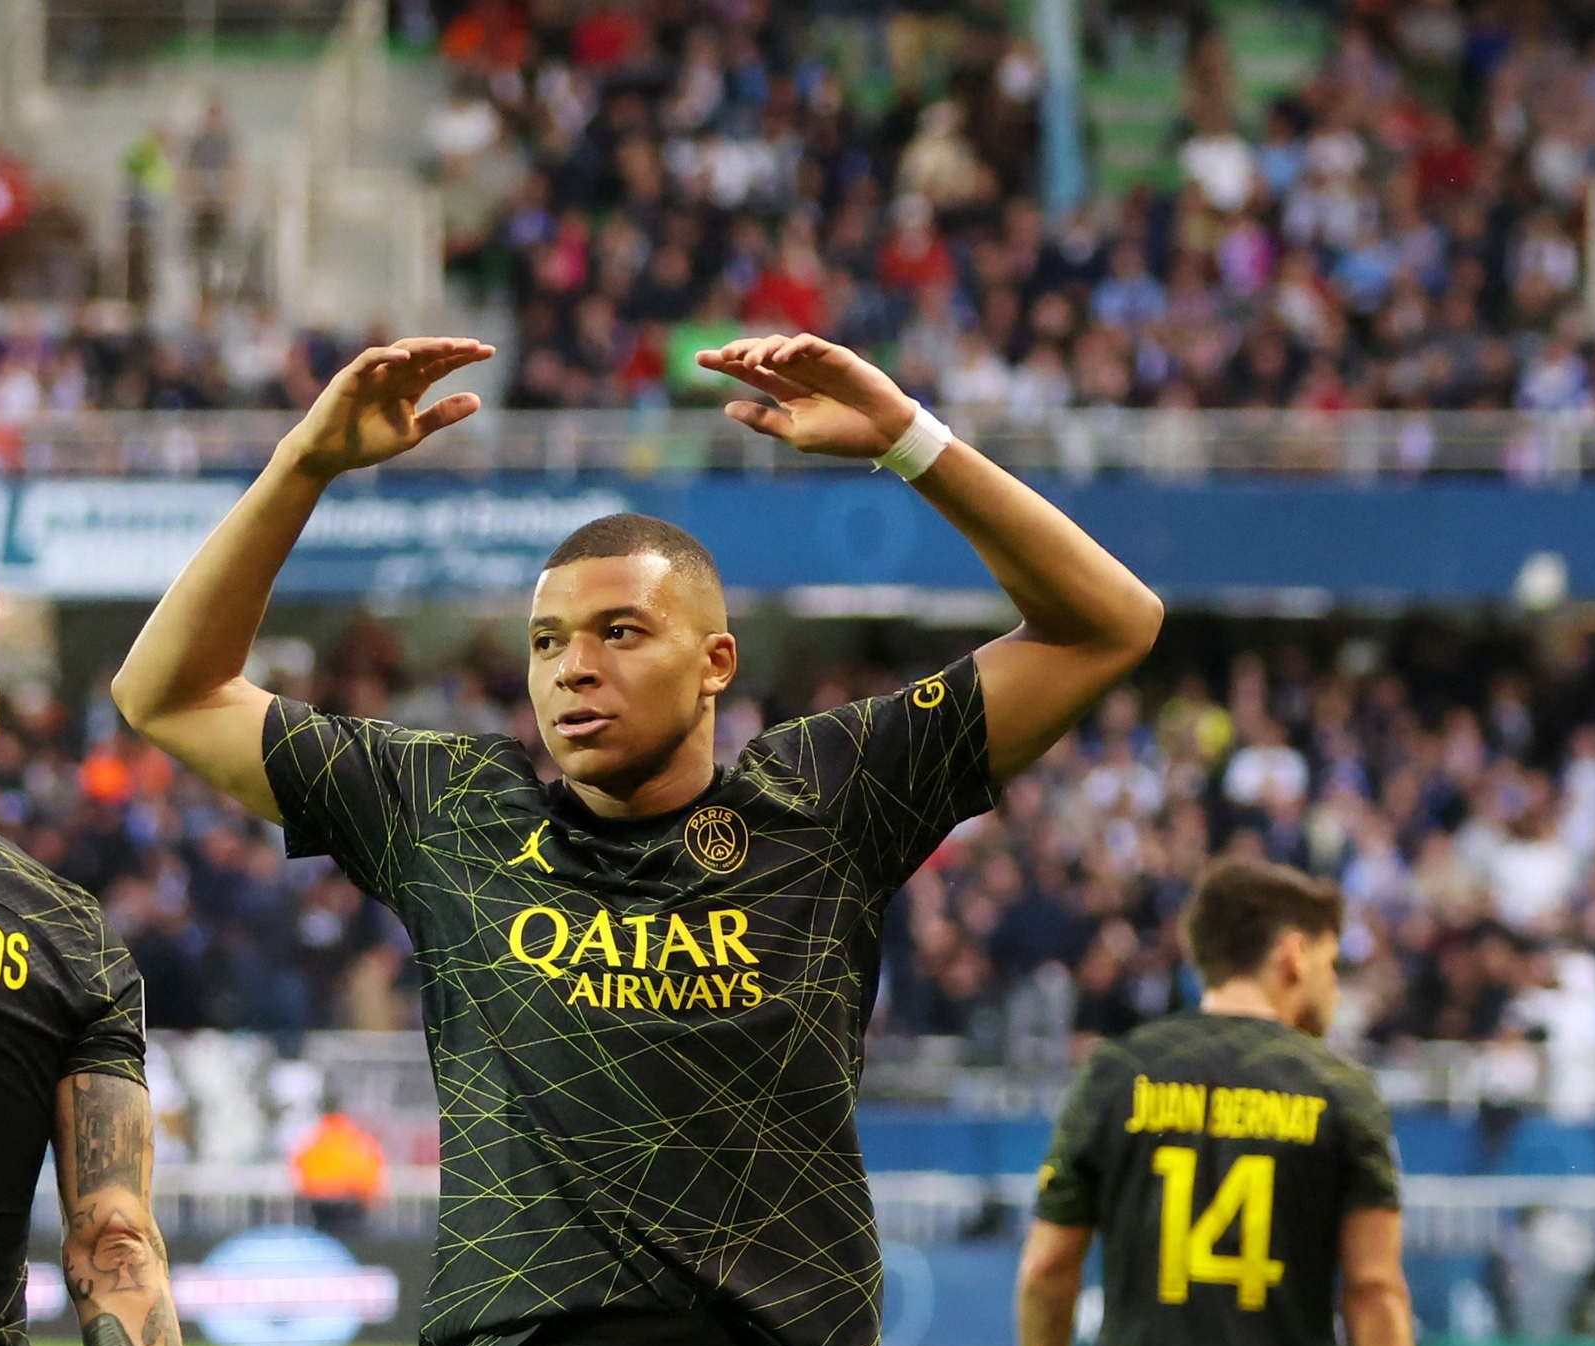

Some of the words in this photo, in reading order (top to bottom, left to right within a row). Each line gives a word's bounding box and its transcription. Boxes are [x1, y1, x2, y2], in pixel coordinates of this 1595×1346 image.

[690, 808, 734, 831] PARIS
[509, 905, 760, 978] QATAR
[567, 969, 764, 1011] AIRWAYS
[1124, 1074, 1207, 1134] JUAN
[1208, 1086, 1328, 1145] BERNAT
[1152, 1145, 1285, 1312] 14
